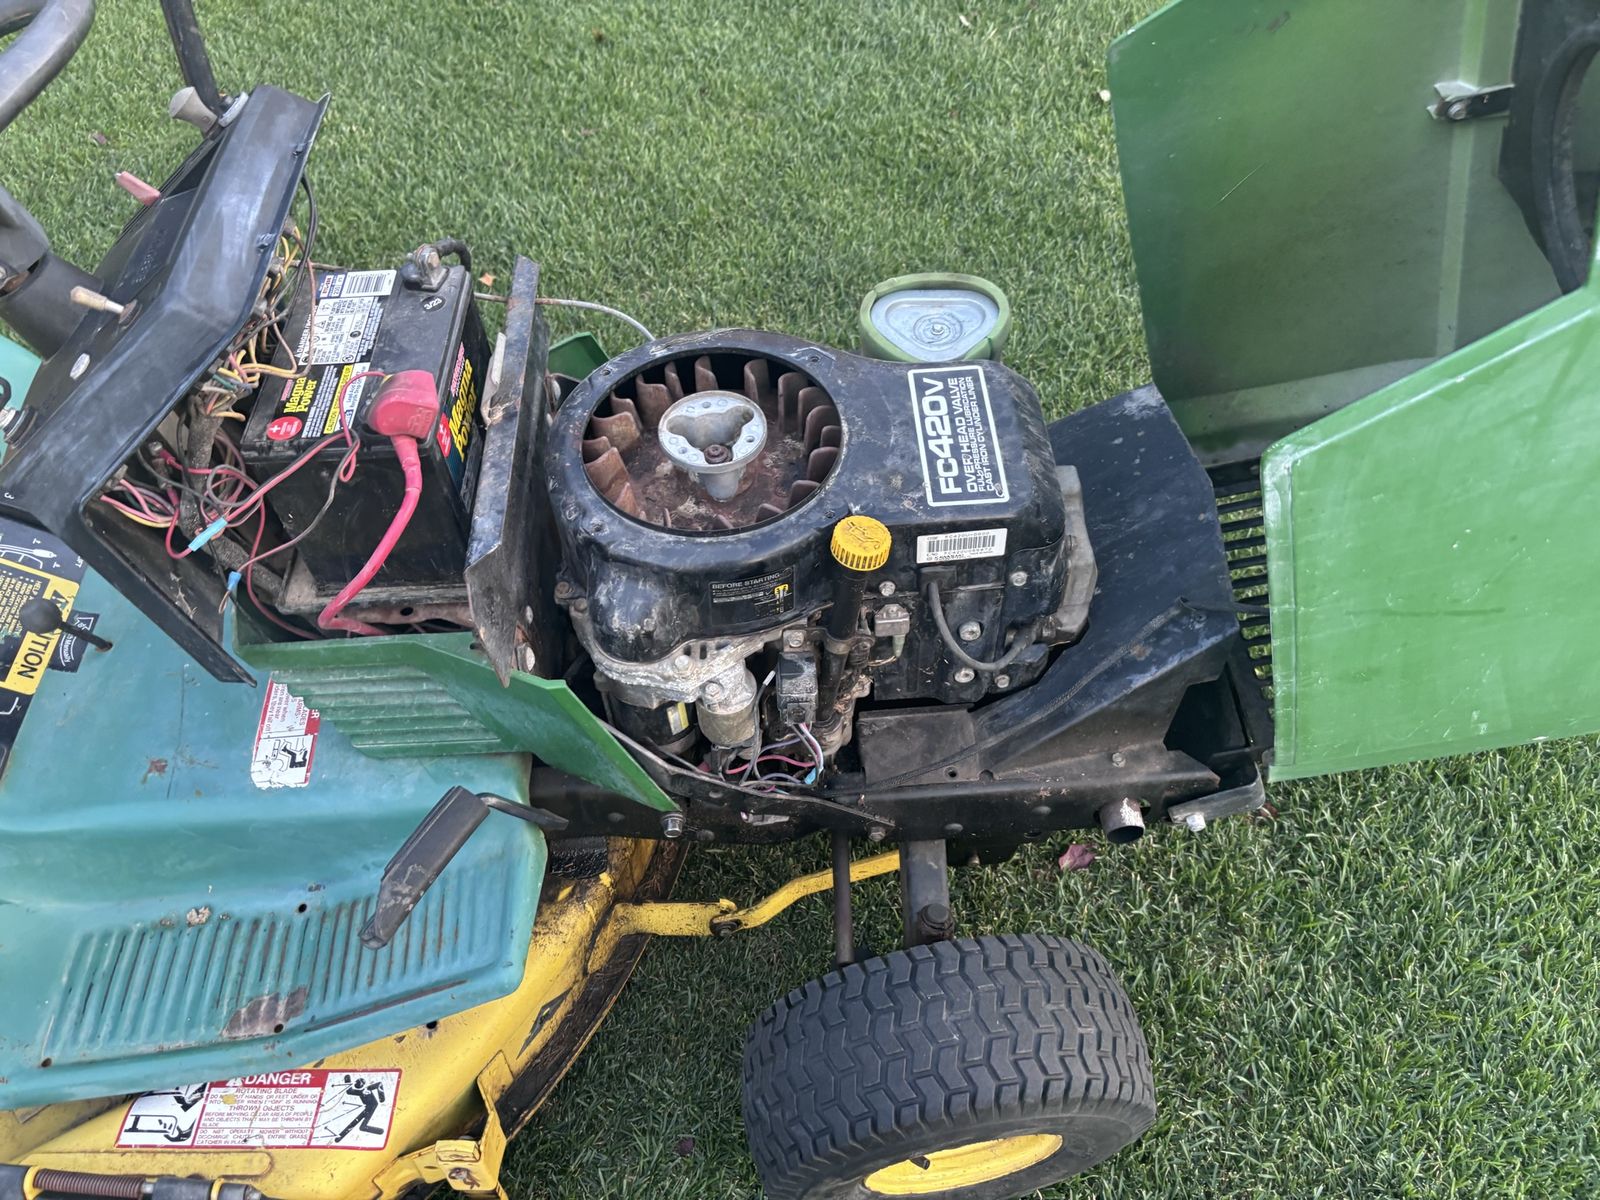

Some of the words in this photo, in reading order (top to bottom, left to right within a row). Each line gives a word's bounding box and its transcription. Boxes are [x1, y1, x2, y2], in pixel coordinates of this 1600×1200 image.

[283, 376, 307, 413] Magna
[296, 380, 317, 412] Power
[449, 358, 472, 444] Magna
[948, 377, 962, 413] VALVE
[958, 377, 972, 425] LUBRICATION
[965, 376, 975, 399] LINER
[456, 382, 476, 462] Power
[922, 377, 962, 494] FC420V
[955, 416, 970, 452] HEAD
[972, 401, 984, 441] CYLINDER
[968, 428, 981, 468] PRESSURE
[979, 444, 989, 464] IRON
[961, 454, 978, 491] OVER
[983, 467, 993, 490] CAST
[744, 572, 780, 586] STARTING
[17, 637, 52, 679] TION
[244, 1073, 312, 1085] DANGER
